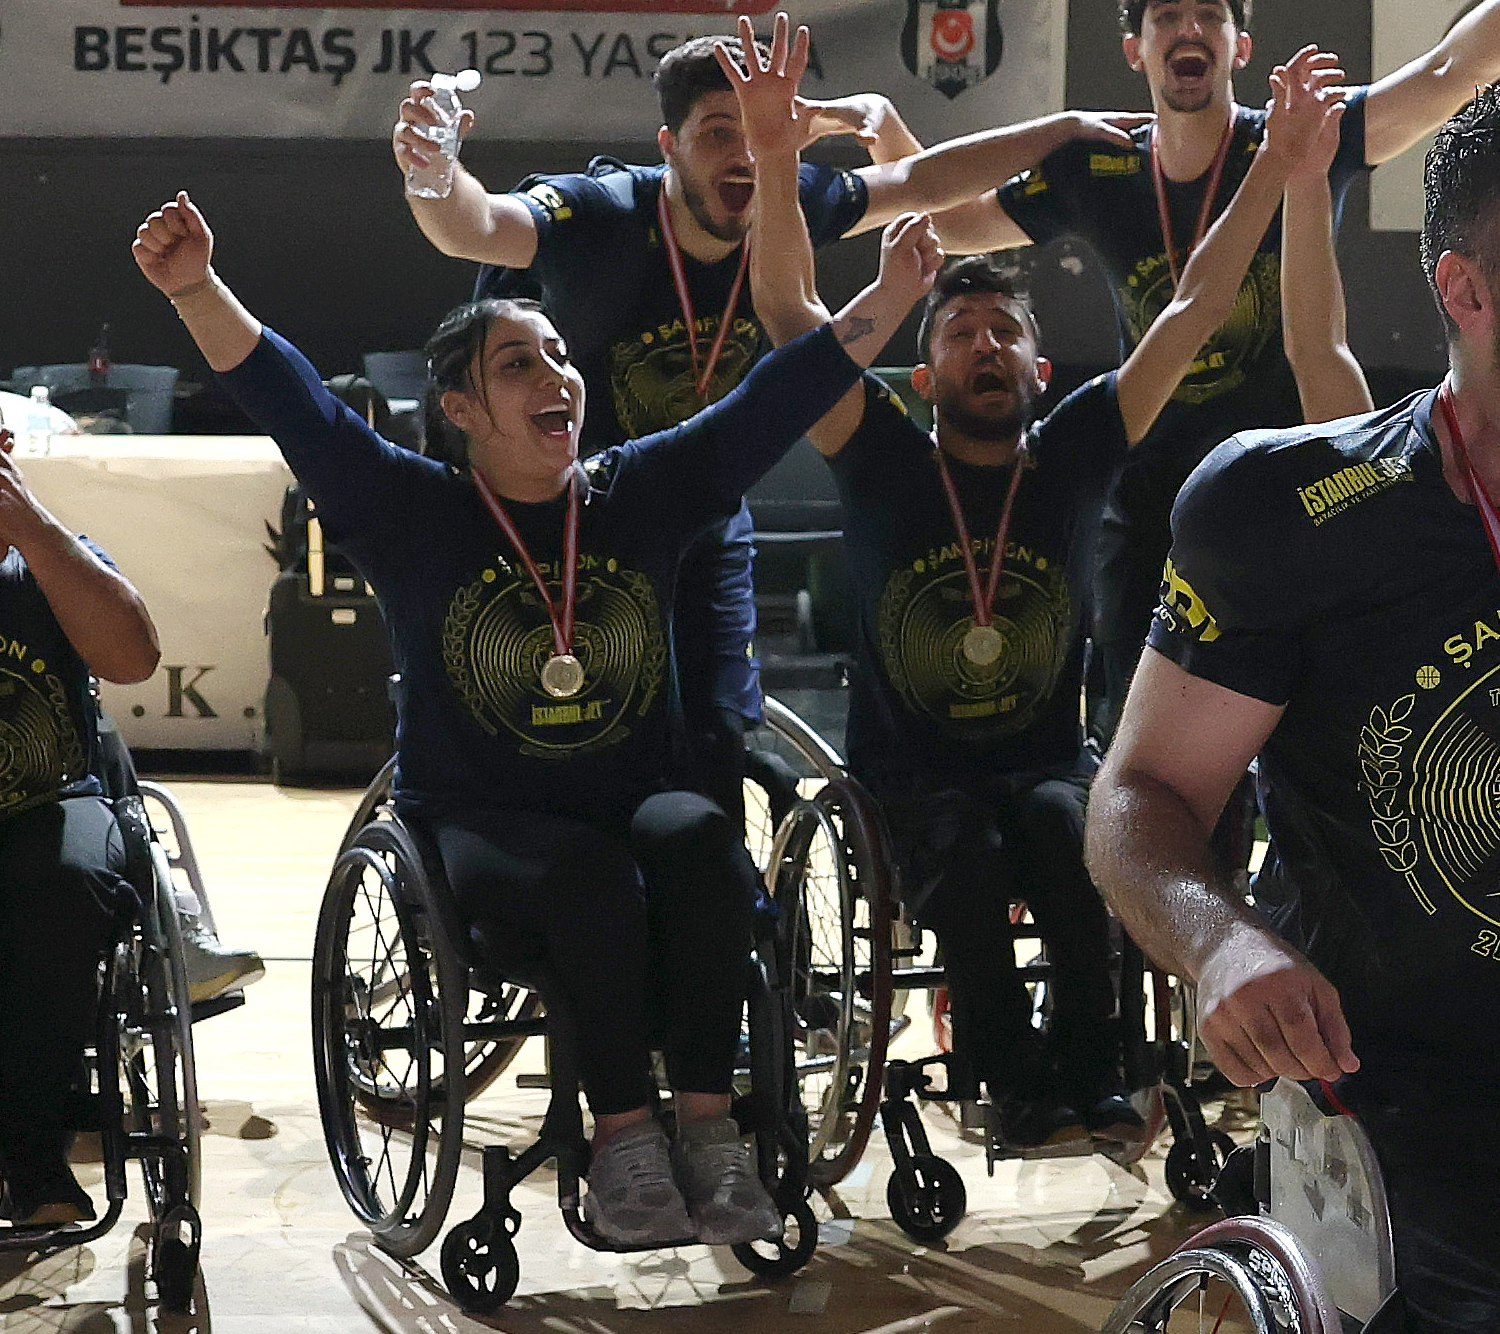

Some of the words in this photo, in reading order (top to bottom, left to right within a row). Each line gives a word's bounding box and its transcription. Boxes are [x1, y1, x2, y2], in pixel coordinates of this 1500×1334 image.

[73, 13, 357, 87] BEŞİKTAŞ
[372, 27, 438, 74] JK
[460, 30, 554, 78] 123
